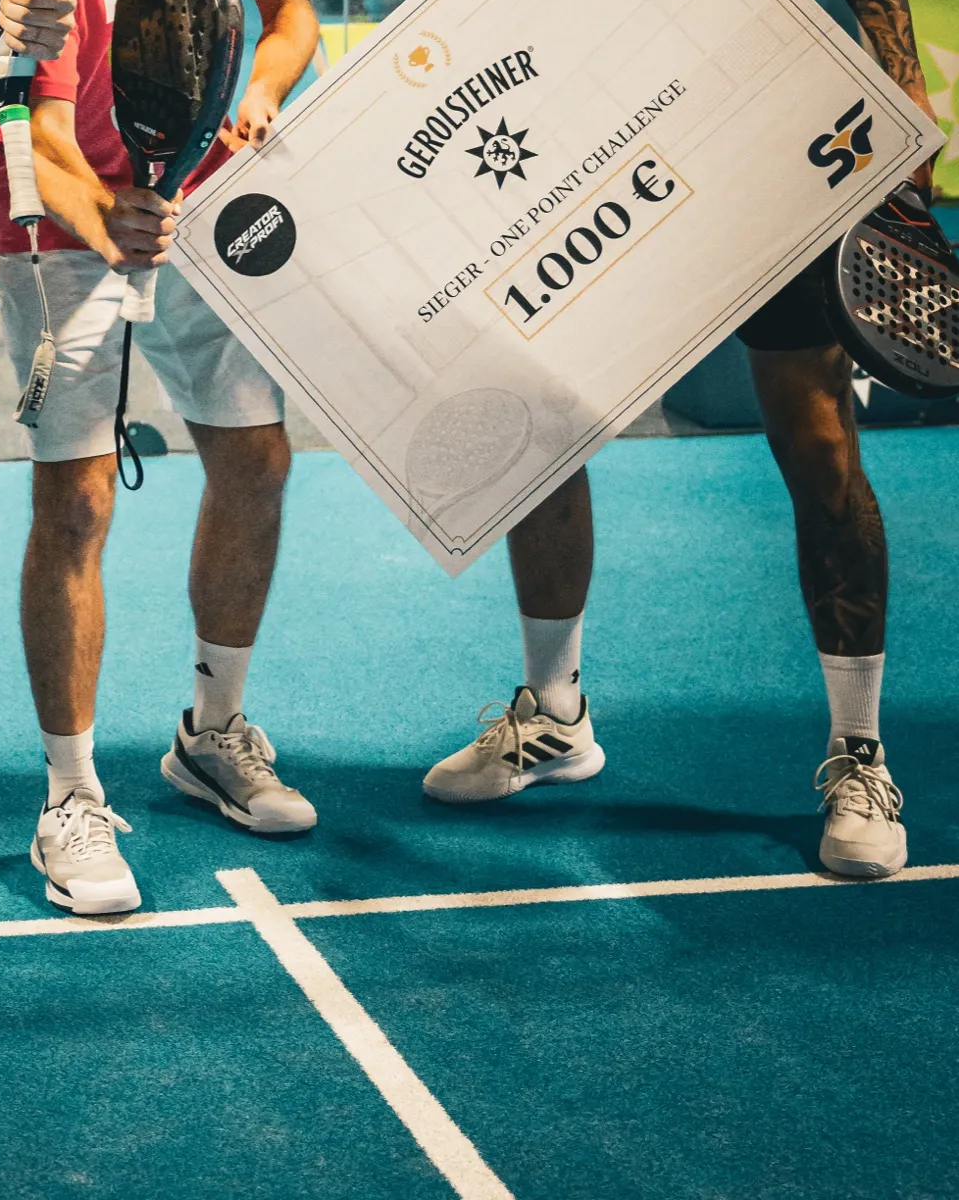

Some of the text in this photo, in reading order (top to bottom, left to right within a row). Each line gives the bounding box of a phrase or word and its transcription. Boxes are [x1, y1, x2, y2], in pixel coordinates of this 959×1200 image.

[227, 204, 282, 258] CREATOR
[249, 214, 284, 249] PROFI
[417, 262, 485, 323] SIEGER
[490, 219, 531, 257] ONE
[526, 169, 584, 225] POINT
[581, 78, 687, 175] CHALLENGE
[504, 159, 675, 324] 1.000 €
